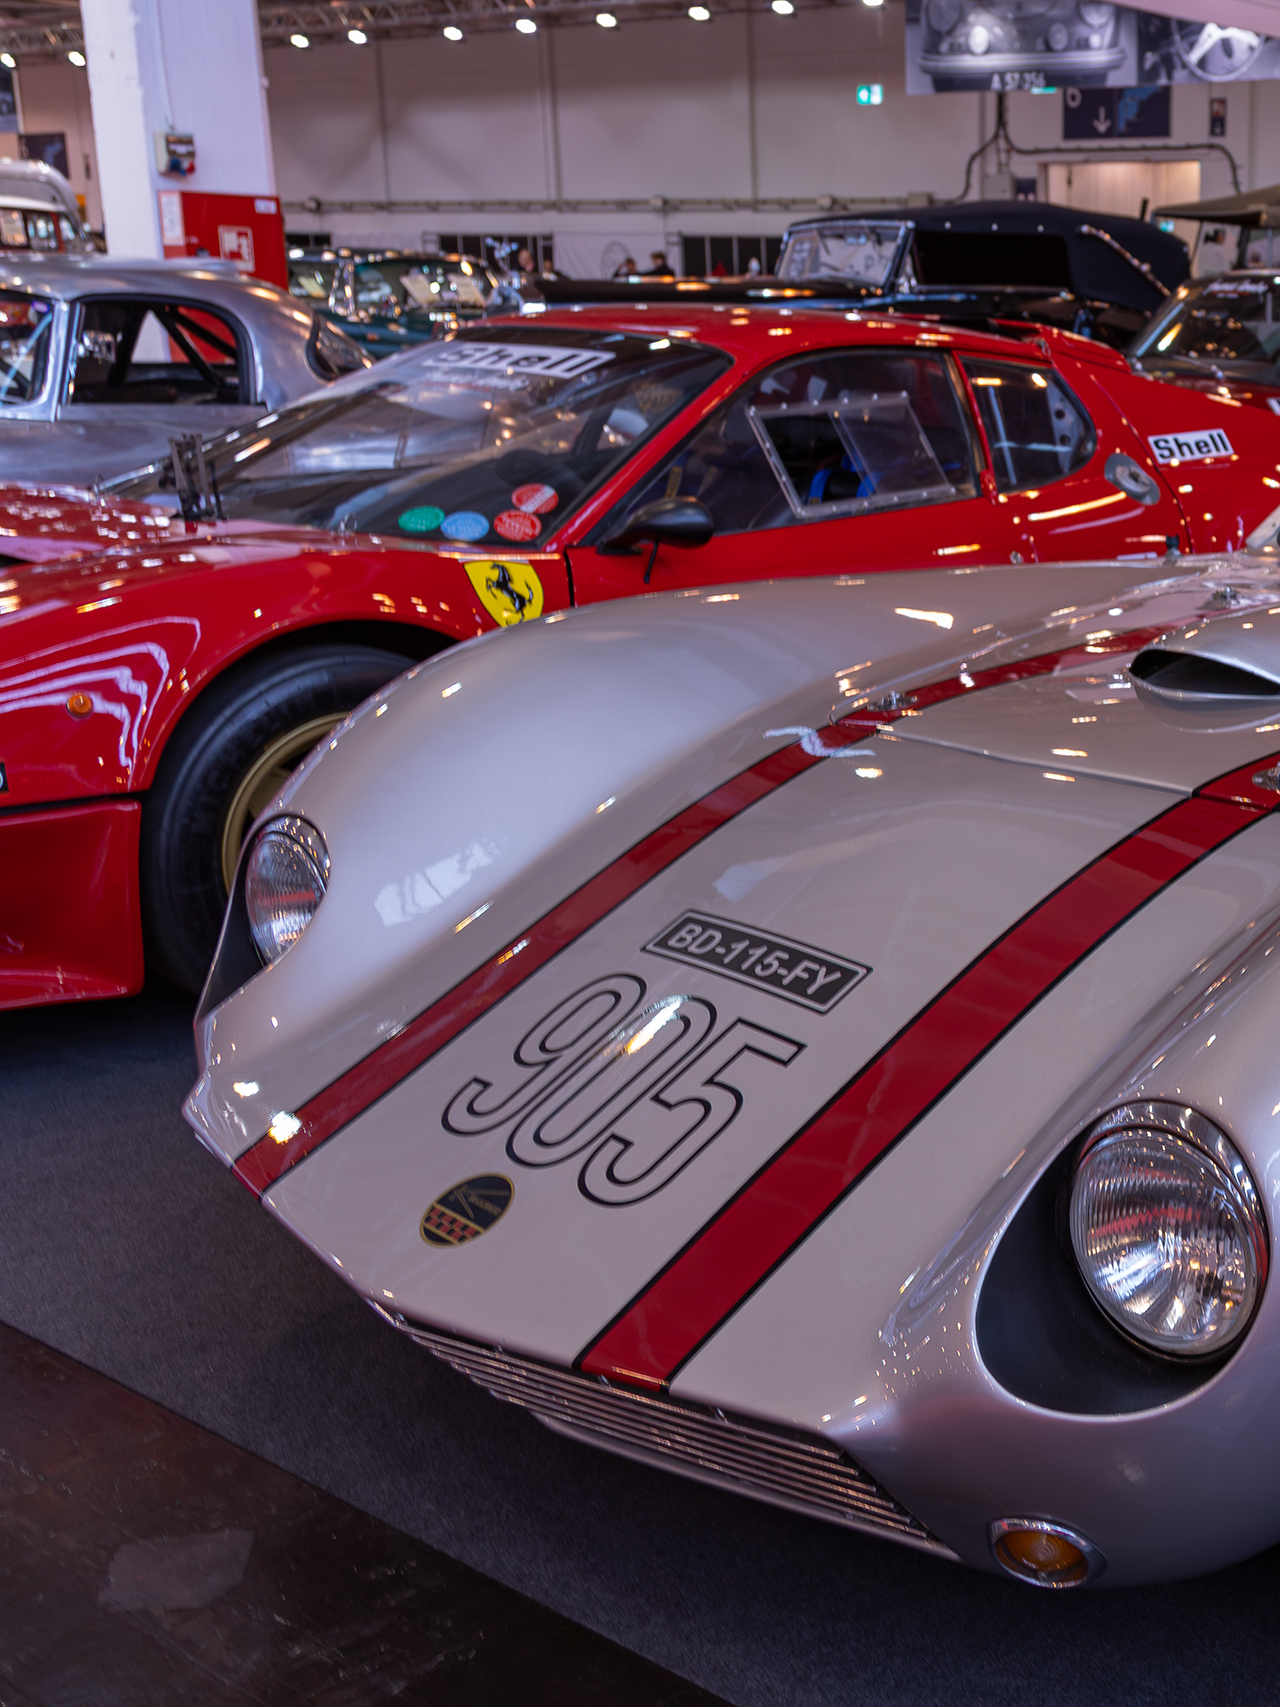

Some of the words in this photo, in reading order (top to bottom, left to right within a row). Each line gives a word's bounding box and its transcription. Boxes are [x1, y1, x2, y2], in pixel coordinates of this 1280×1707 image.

[436, 347, 602, 373] Shell
[1153, 432, 1229, 460] Shell
[667, 921, 842, 996] BD-115-FY
[441, 970, 808, 1207] 905
